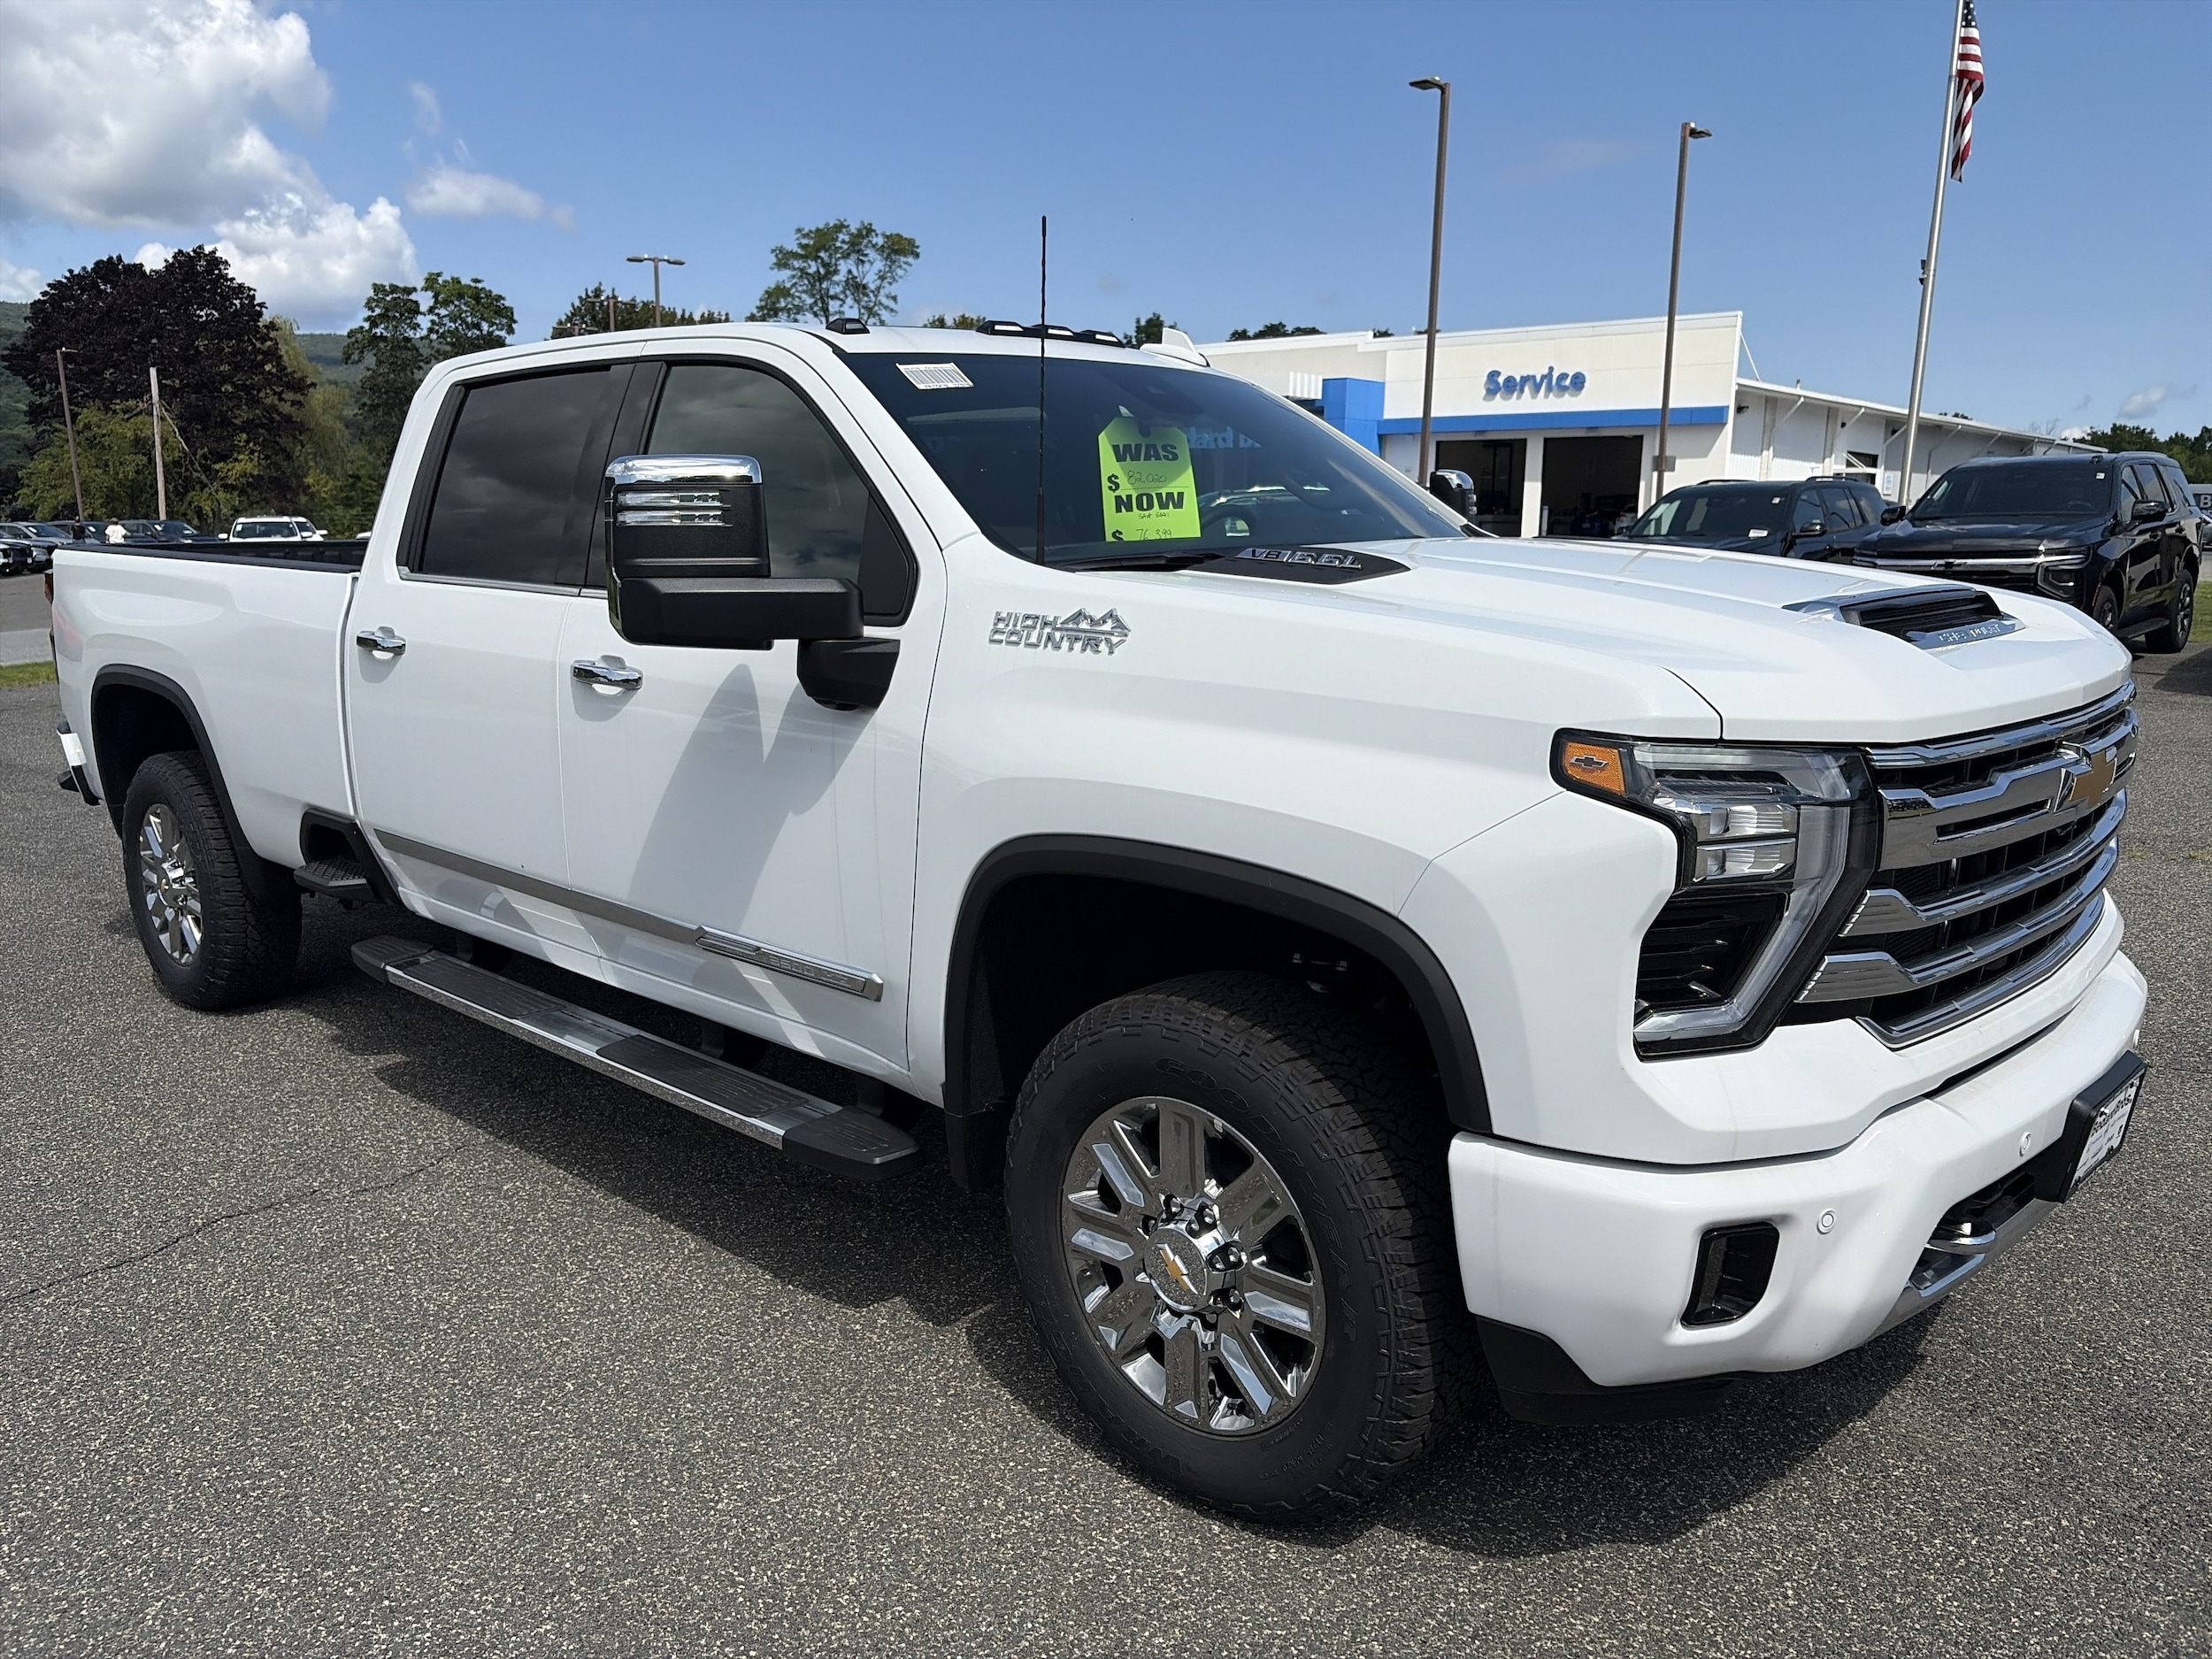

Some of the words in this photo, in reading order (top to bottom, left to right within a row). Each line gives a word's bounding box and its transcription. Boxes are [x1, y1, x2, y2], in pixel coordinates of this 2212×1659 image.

[1483, 365, 1586, 397] Service
[1111, 443, 1179, 463] WAS
[1106, 473, 1120, 494] $
[1114, 491, 1185, 514] NOW
[992, 611, 1062, 631] HIGH
[988, 627, 1127, 656] COUNTRY
[1152, 1056, 1359, 1343] GOODYEAR
